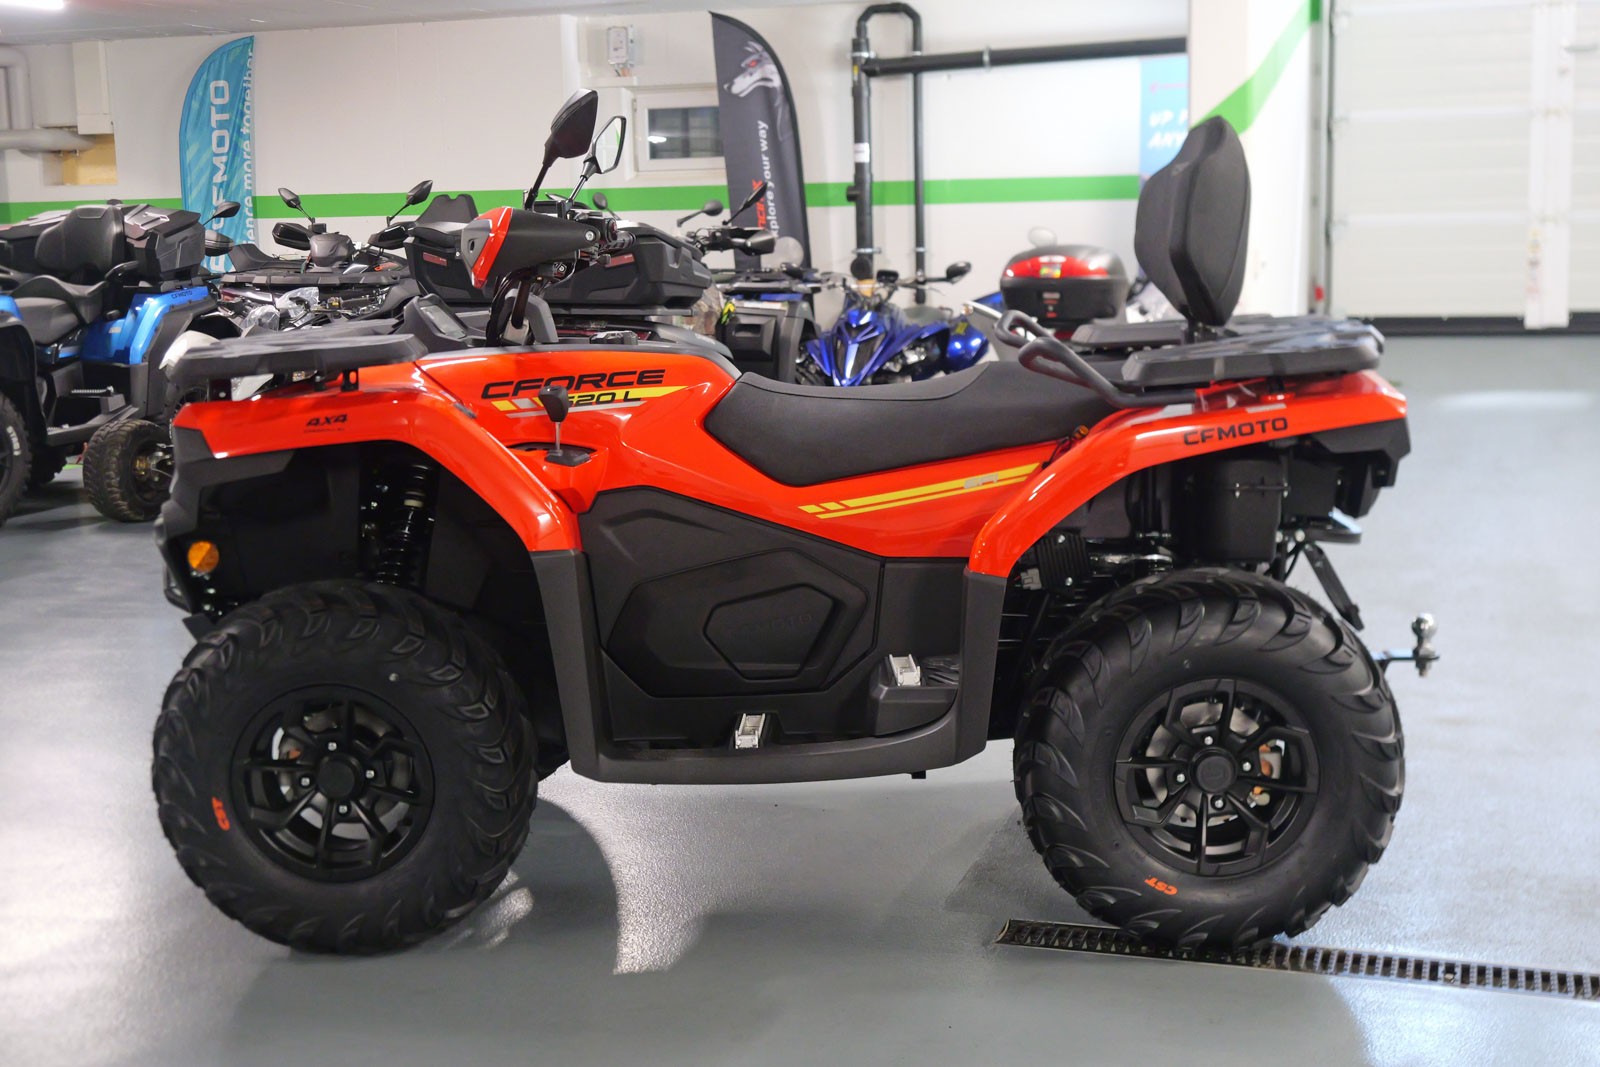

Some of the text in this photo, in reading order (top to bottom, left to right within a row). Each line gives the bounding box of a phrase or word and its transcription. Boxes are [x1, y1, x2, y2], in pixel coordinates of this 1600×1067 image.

[757, 120, 769, 151] way
[241, 140, 253, 190] more
[243, 196, 254, 244] ience
[767, 190, 780, 238] xplore
[481, 369, 666, 399] CFORCE
[623, 391, 641, 402] L
[1183, 417, 1288, 446] CFMOTO
[1144, 876, 1178, 896] CST
